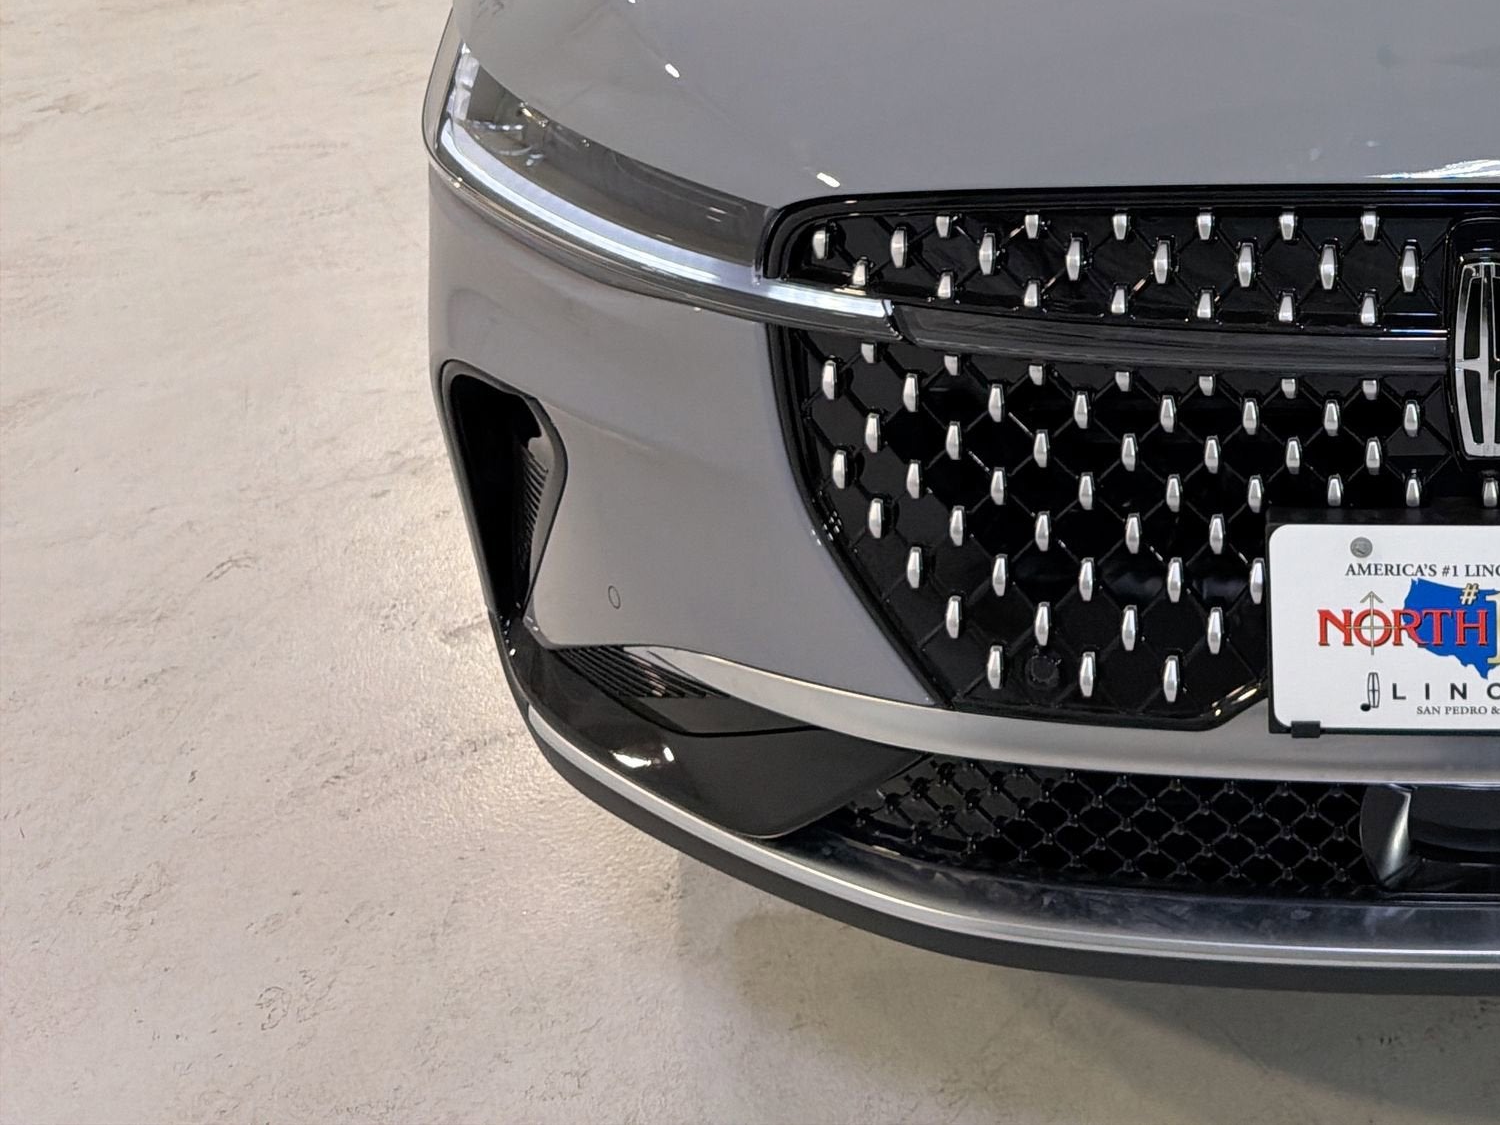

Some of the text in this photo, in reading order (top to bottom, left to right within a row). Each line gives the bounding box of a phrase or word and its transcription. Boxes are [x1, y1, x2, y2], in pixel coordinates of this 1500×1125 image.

[1345, 562, 1438, 577] AMERICA'S
[1442, 563, 1459, 577] #1
[1317, 608, 1488, 647] NORTH
[1416, 705, 1442, 716] SAN
[1444, 705, 1488, 716] PEDRO
